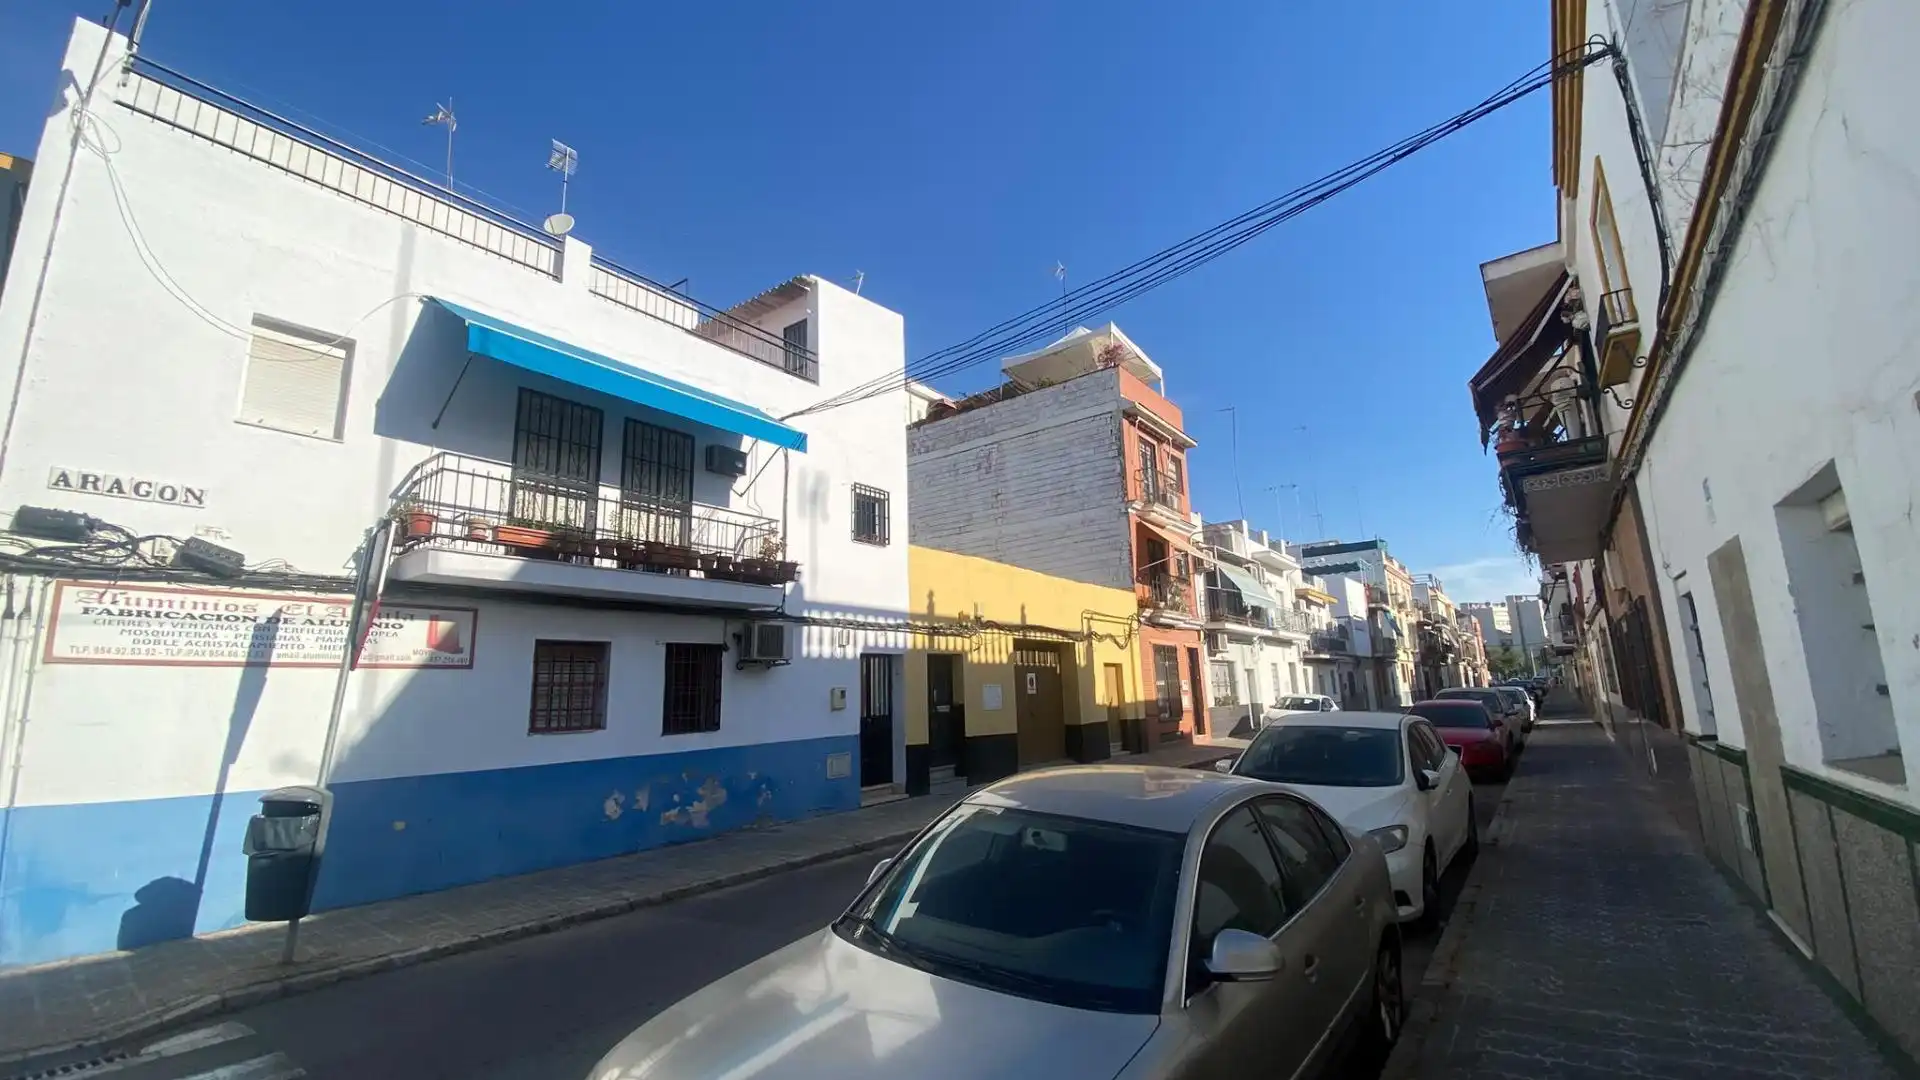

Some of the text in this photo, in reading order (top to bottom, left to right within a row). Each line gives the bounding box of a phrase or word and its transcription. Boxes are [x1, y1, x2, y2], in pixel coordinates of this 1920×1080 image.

[51, 470, 205, 505] ARAGON
[80, 606, 259, 623] FABRICACION
[265, 616, 297, 626] DE
[279, 602, 314, 617] El
[94, 618, 152, 628] CIERRES
[171, 621, 241, 632] VENTANAS
[245, 623, 271, 632] CON
[119, 628, 219, 640] MOSQUITERAS
[132, 637, 180, 647] DOBLE
[184, 639, 305, 651] ACRISTALAMIENTO
